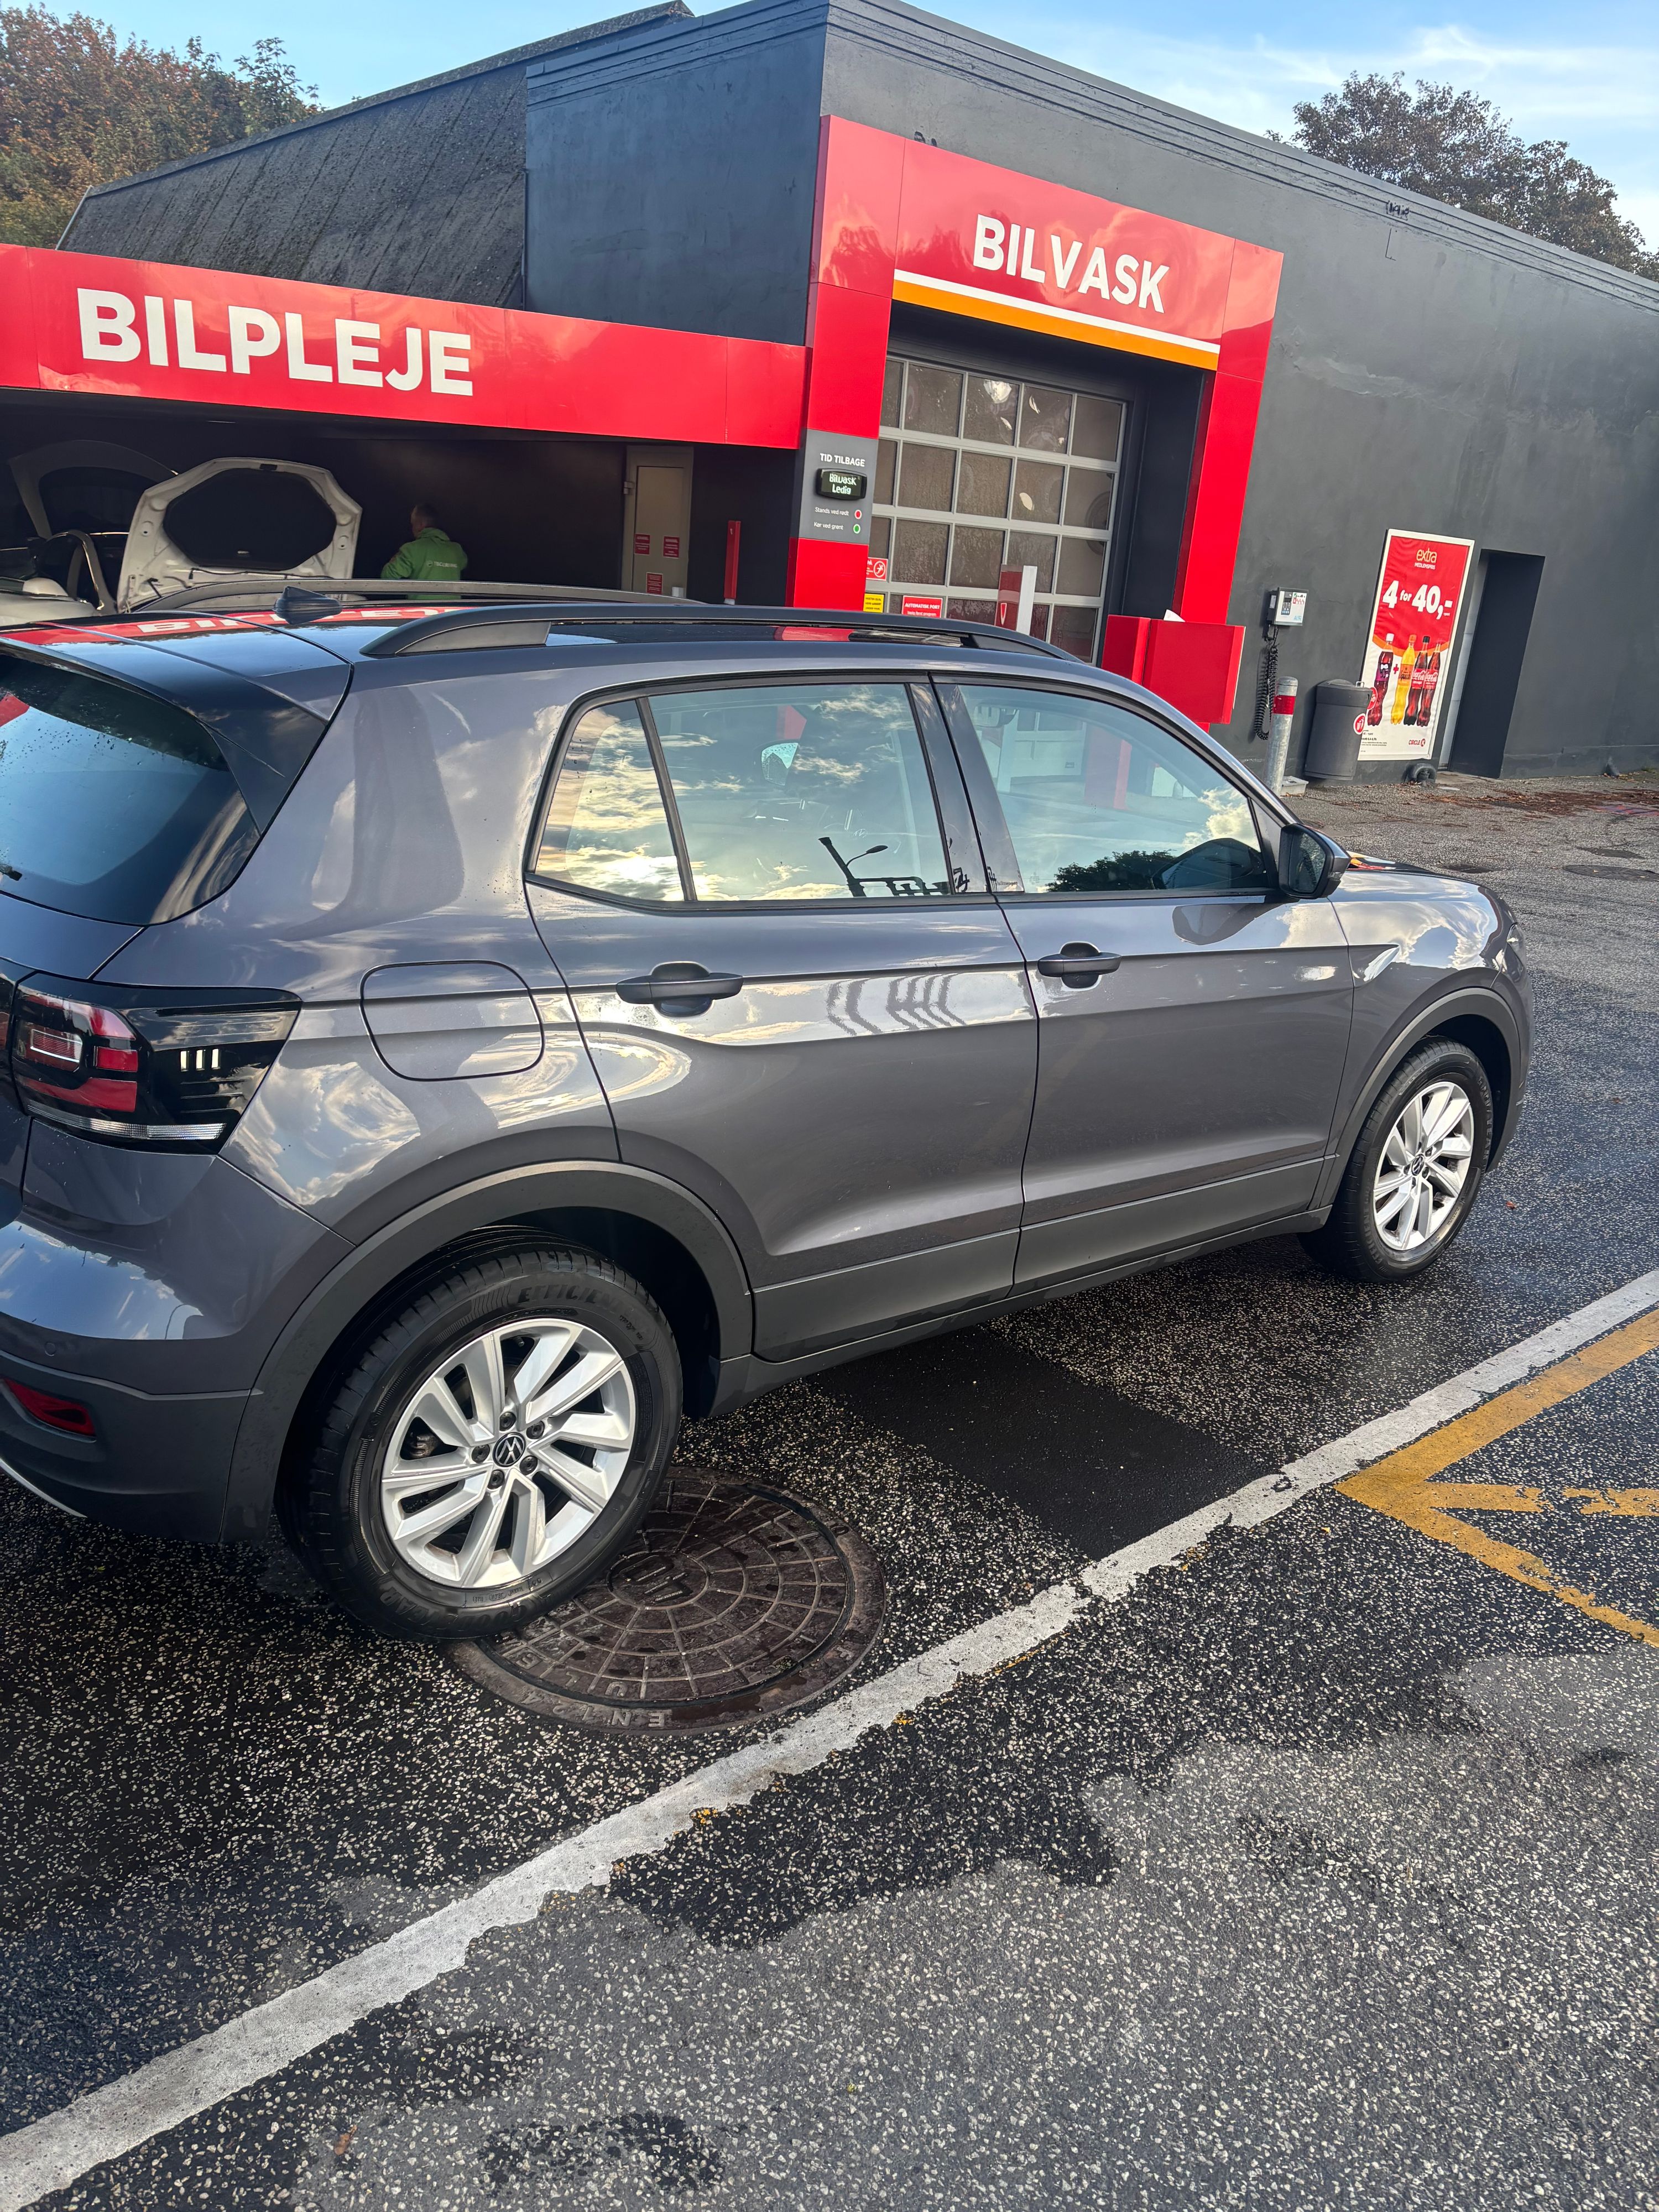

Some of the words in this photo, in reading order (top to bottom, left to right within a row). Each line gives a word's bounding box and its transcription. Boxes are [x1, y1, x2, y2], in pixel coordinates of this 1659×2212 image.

[972, 213, 1170, 314] BILVASK
[76, 288, 473, 397] BILPLEJE
[820, 453, 832, 461] TID
[834, 455, 865, 467] TILBAGE
[832, 484, 852, 495] Ledig
[1416, 547, 1438, 564] extra
[1382, 580, 1399, 609] 4
[1400, 589, 1412, 602] for
